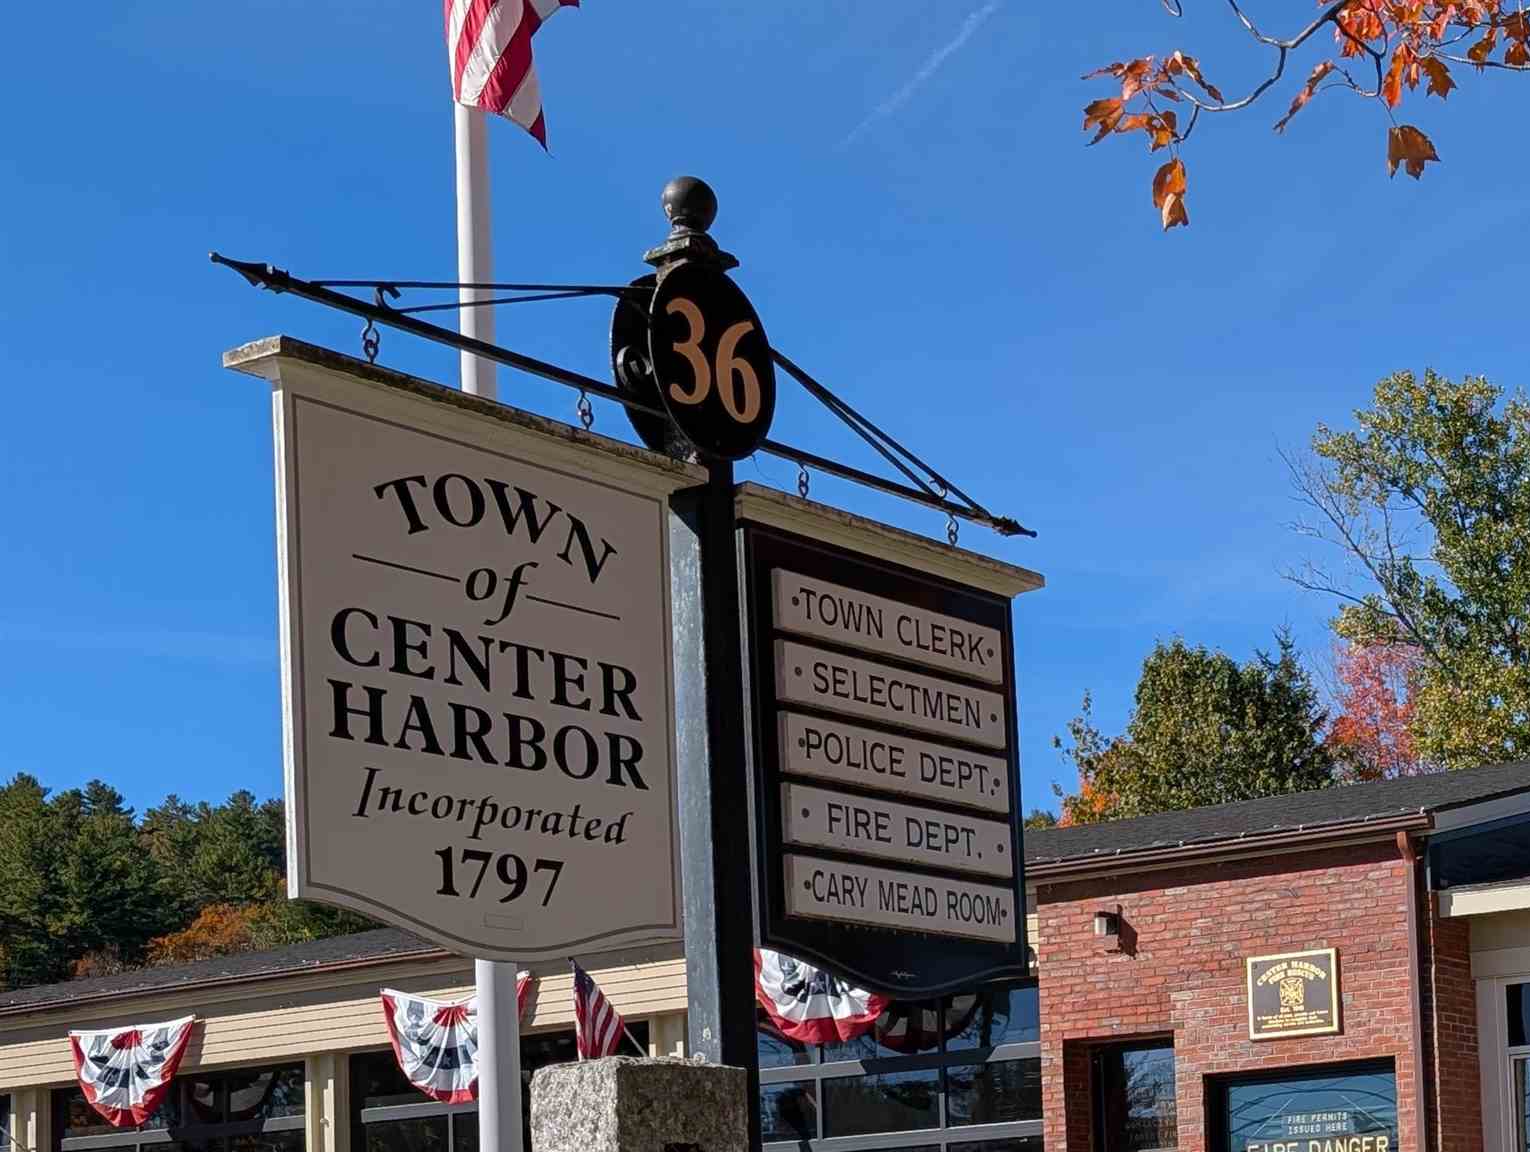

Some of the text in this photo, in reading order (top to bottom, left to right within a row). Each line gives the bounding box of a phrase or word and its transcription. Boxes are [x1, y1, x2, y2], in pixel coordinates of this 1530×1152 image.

[666, 297, 761, 424] 36
[373, 472, 618, 584] TOWN
[465, 561, 539, 626] of
[799, 587, 986, 665] TOWN CLERK
[330, 607, 643, 722] CENTER
[812, 661, 981, 730] SELECTMEN
[327, 677, 650, 791] HARBOR
[804, 727, 996, 797] POLICE DEPT.
[352, 766, 634, 846] Incorporated
[826, 802, 983, 860] FIRE DEPT.
[434, 846, 565, 907] 1797
[811, 869, 1001, 927] CARY MEAD ROOM
[1287, 1111, 1348, 1125] FIRE PERMITS
[1287, 1122, 1348, 1135] ISSUED HERE
